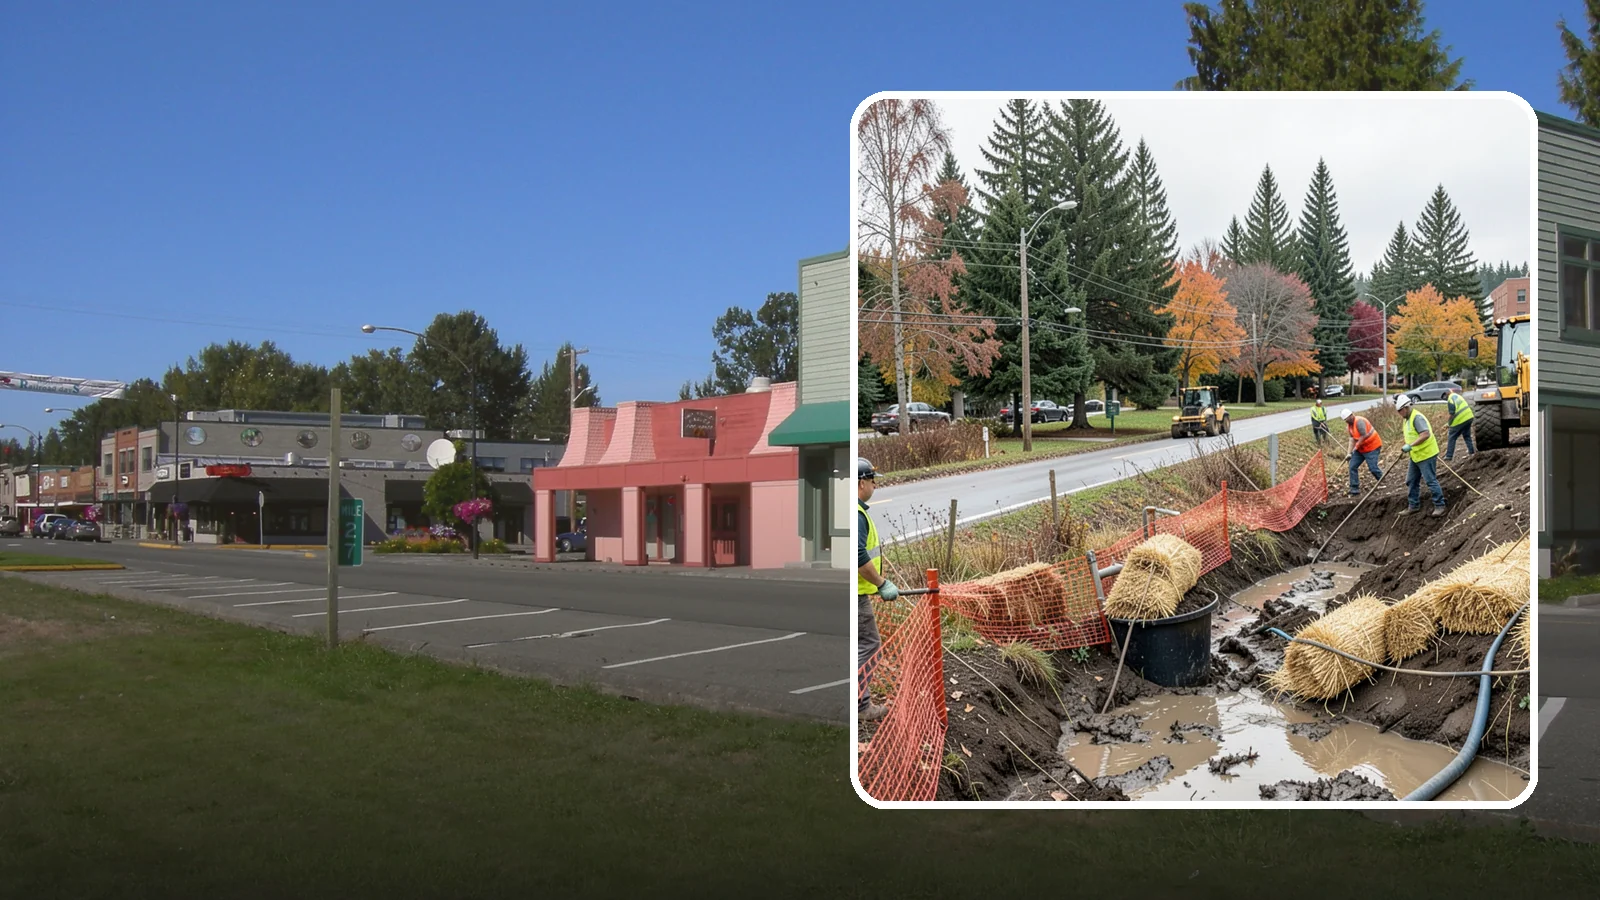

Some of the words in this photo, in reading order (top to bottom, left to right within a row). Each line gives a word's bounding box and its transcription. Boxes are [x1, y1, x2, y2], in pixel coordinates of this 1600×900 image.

[341, 505, 361, 517] MILE
[344, 522, 357, 539] 2
[344, 543, 356, 559] 7
